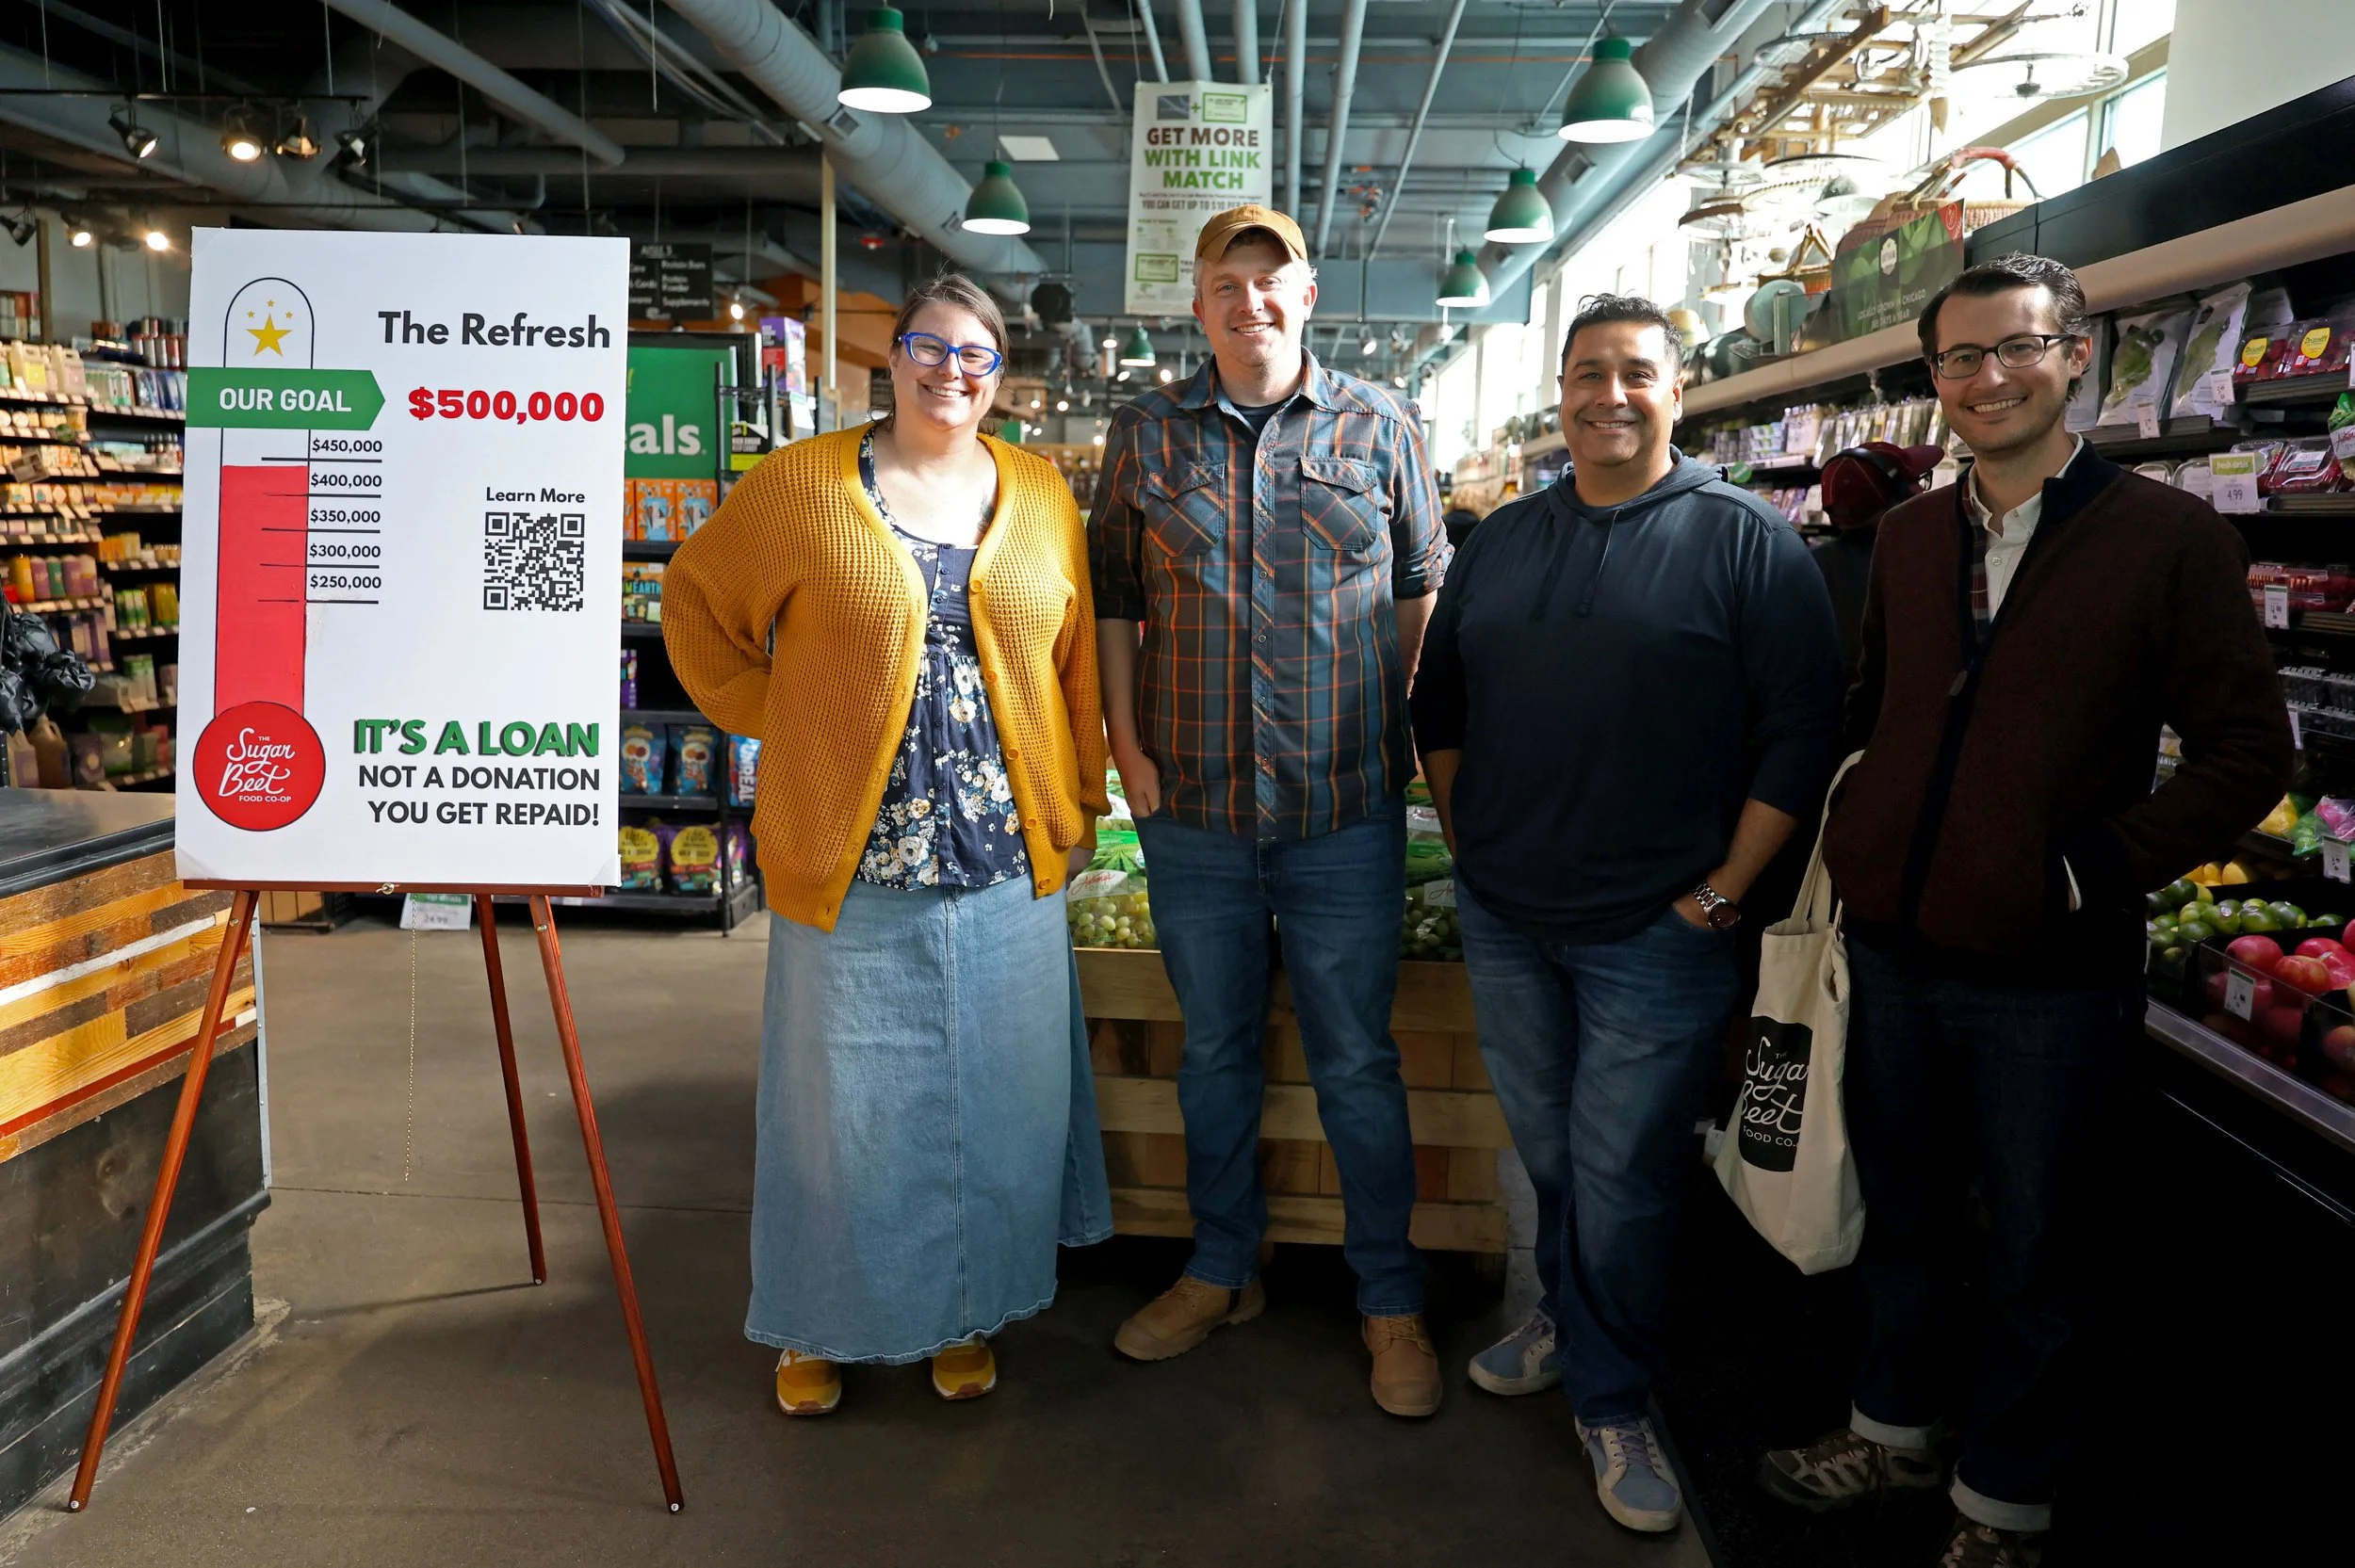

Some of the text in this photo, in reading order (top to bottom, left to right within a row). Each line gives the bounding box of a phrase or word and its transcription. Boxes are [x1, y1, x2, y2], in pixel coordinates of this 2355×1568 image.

[1146, 127, 1259, 147] GET MORE
[1144, 149, 1261, 169] WITH LINK
[1162, 170, 1243, 189] MATCH
[1171, 200, 1185, 210] GET
[1187, 200, 1197, 210] UP
[1903, 288, 1926, 305] CHICAGO
[378, 311, 610, 348] The Refresh
[219, 388, 352, 412] OUR GOAL
[408, 386, 605, 425] $500,000
[312, 438, 382, 454] $450,000
[311, 473, 382, 489] $400,000
[486, 487, 585, 503] Learn More
[2227, 489, 2243, 501] 4.99
[310, 509, 381, 525] $350,000
[309, 543, 381, 559] $300,000
[310, 574, 382, 590] $250,000
[353, 719, 600, 757] IT'S A LOAN
[226, 727, 295, 774] Sugar
[219, 762, 291, 797] Beet
[359, 765, 416, 788] NOT
[423, 767, 445, 788] A
[452, 767, 600, 790] DONATION
[367, 800, 599, 826] YOU GET REPAID!
